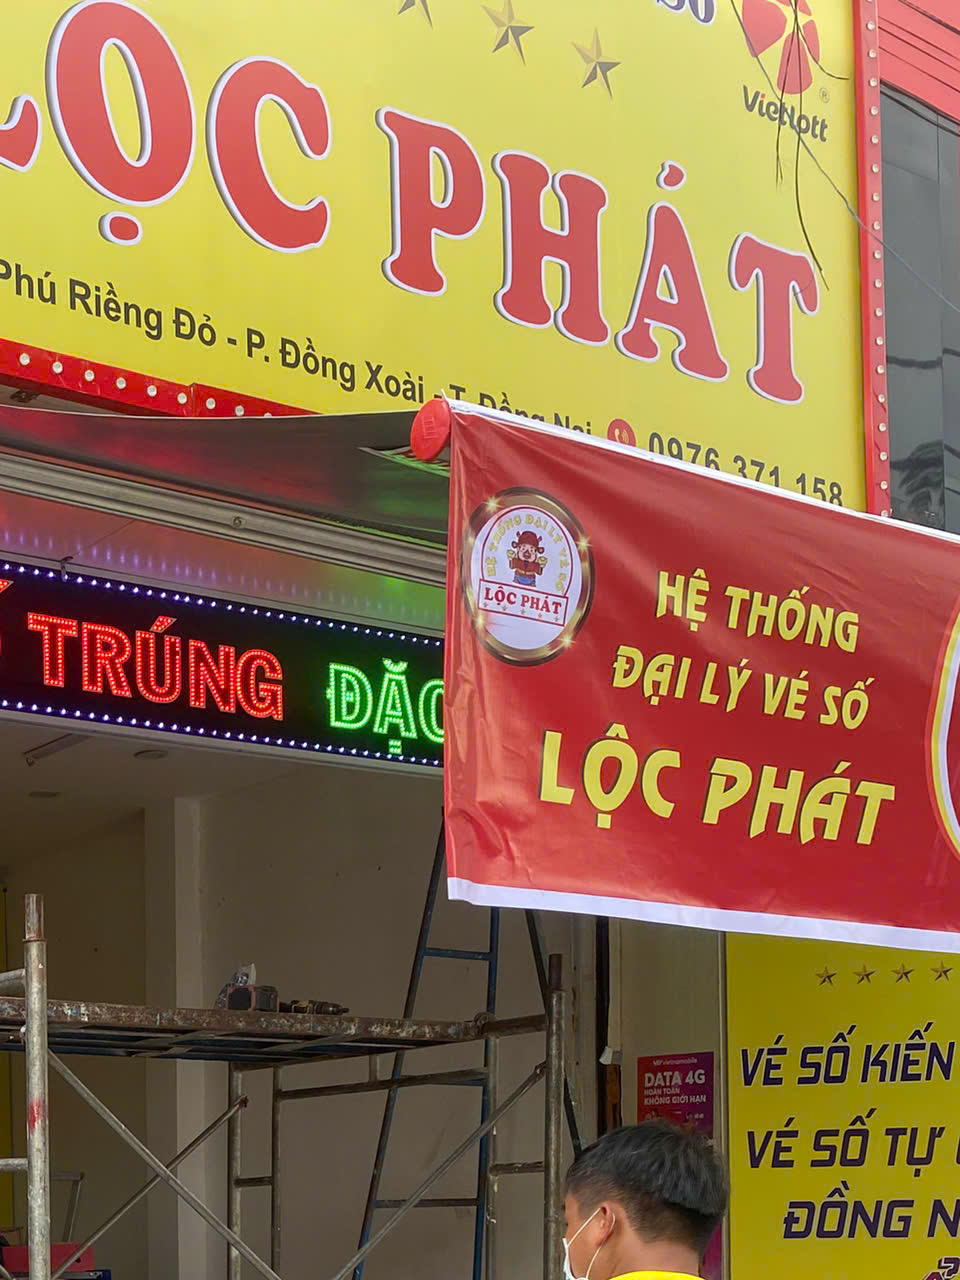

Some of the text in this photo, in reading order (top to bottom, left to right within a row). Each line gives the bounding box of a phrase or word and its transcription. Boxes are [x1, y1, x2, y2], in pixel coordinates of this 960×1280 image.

[742, 84, 828, 143] Vietlott
[375, 106, 820, 404] PHÁT
[68, 281, 164, 342] Riềng
[172, 307, 218, 348] Đỏ
[246, 327, 271, 363] P.
[279, 336, 356, 393] Đồng
[364, 360, 425, 404] Xoài
[648, 431, 844, 508] 0976 371 158
[484, 586, 562, 615] LỘC PHÁT
[655, 567, 861, 654] HỆ THỐNG
[26, 611, 284, 722] TRÚNG
[612, 644, 875, 730] ĐẠI LÝ VÉ SỐ
[538, 721, 897, 845] LỘC PHÁT
[644, 1069, 706, 1088] DATA 4G
[741, 1021, 956, 1087] VÉ SỐ KIẾN
[746, 1117, 800, 1169] VÉ
[810, 1107, 877, 1168] SỐ
[884, 1126, 946, 1178] TỰ
[783, 1180, 915, 1240] ĐỒNG
